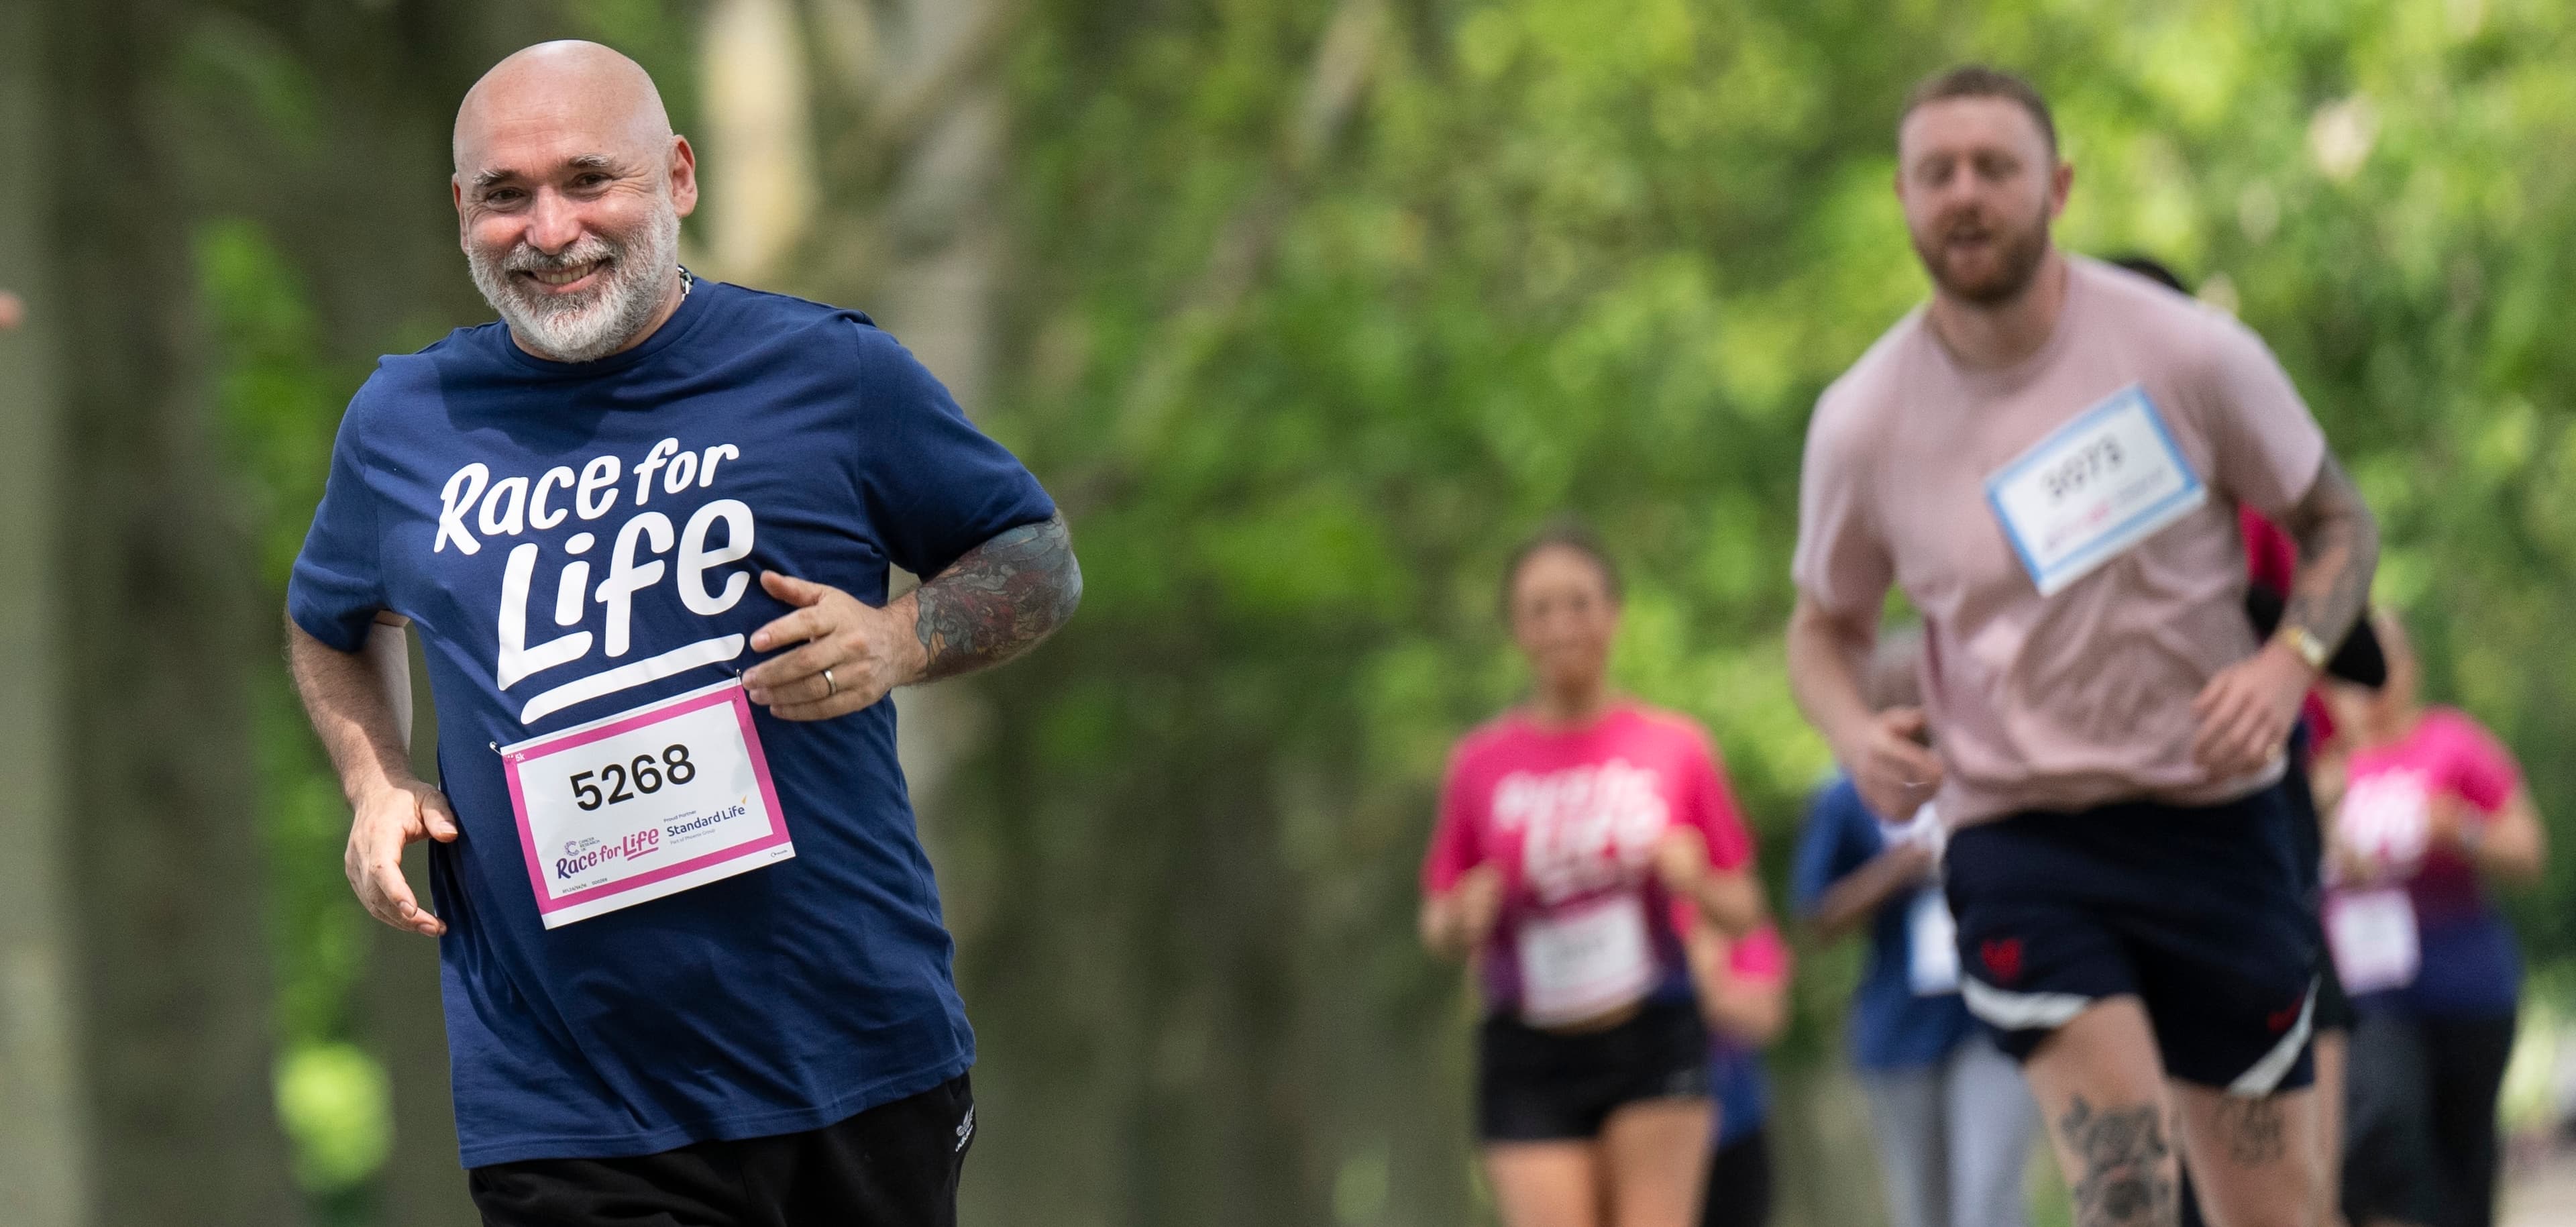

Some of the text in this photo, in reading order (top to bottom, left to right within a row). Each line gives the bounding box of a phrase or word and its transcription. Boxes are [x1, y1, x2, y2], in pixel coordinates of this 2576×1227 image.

[433, 437, 739, 555] Race for
[497, 499, 754, 691] Life
[515, 753, 525, 761] 5k
[570, 743, 696, 811] 5268
[667, 806, 745, 837] Standard Life
[679, 810, 696, 818] Partner
[556, 829, 659, 879] Race for Life
